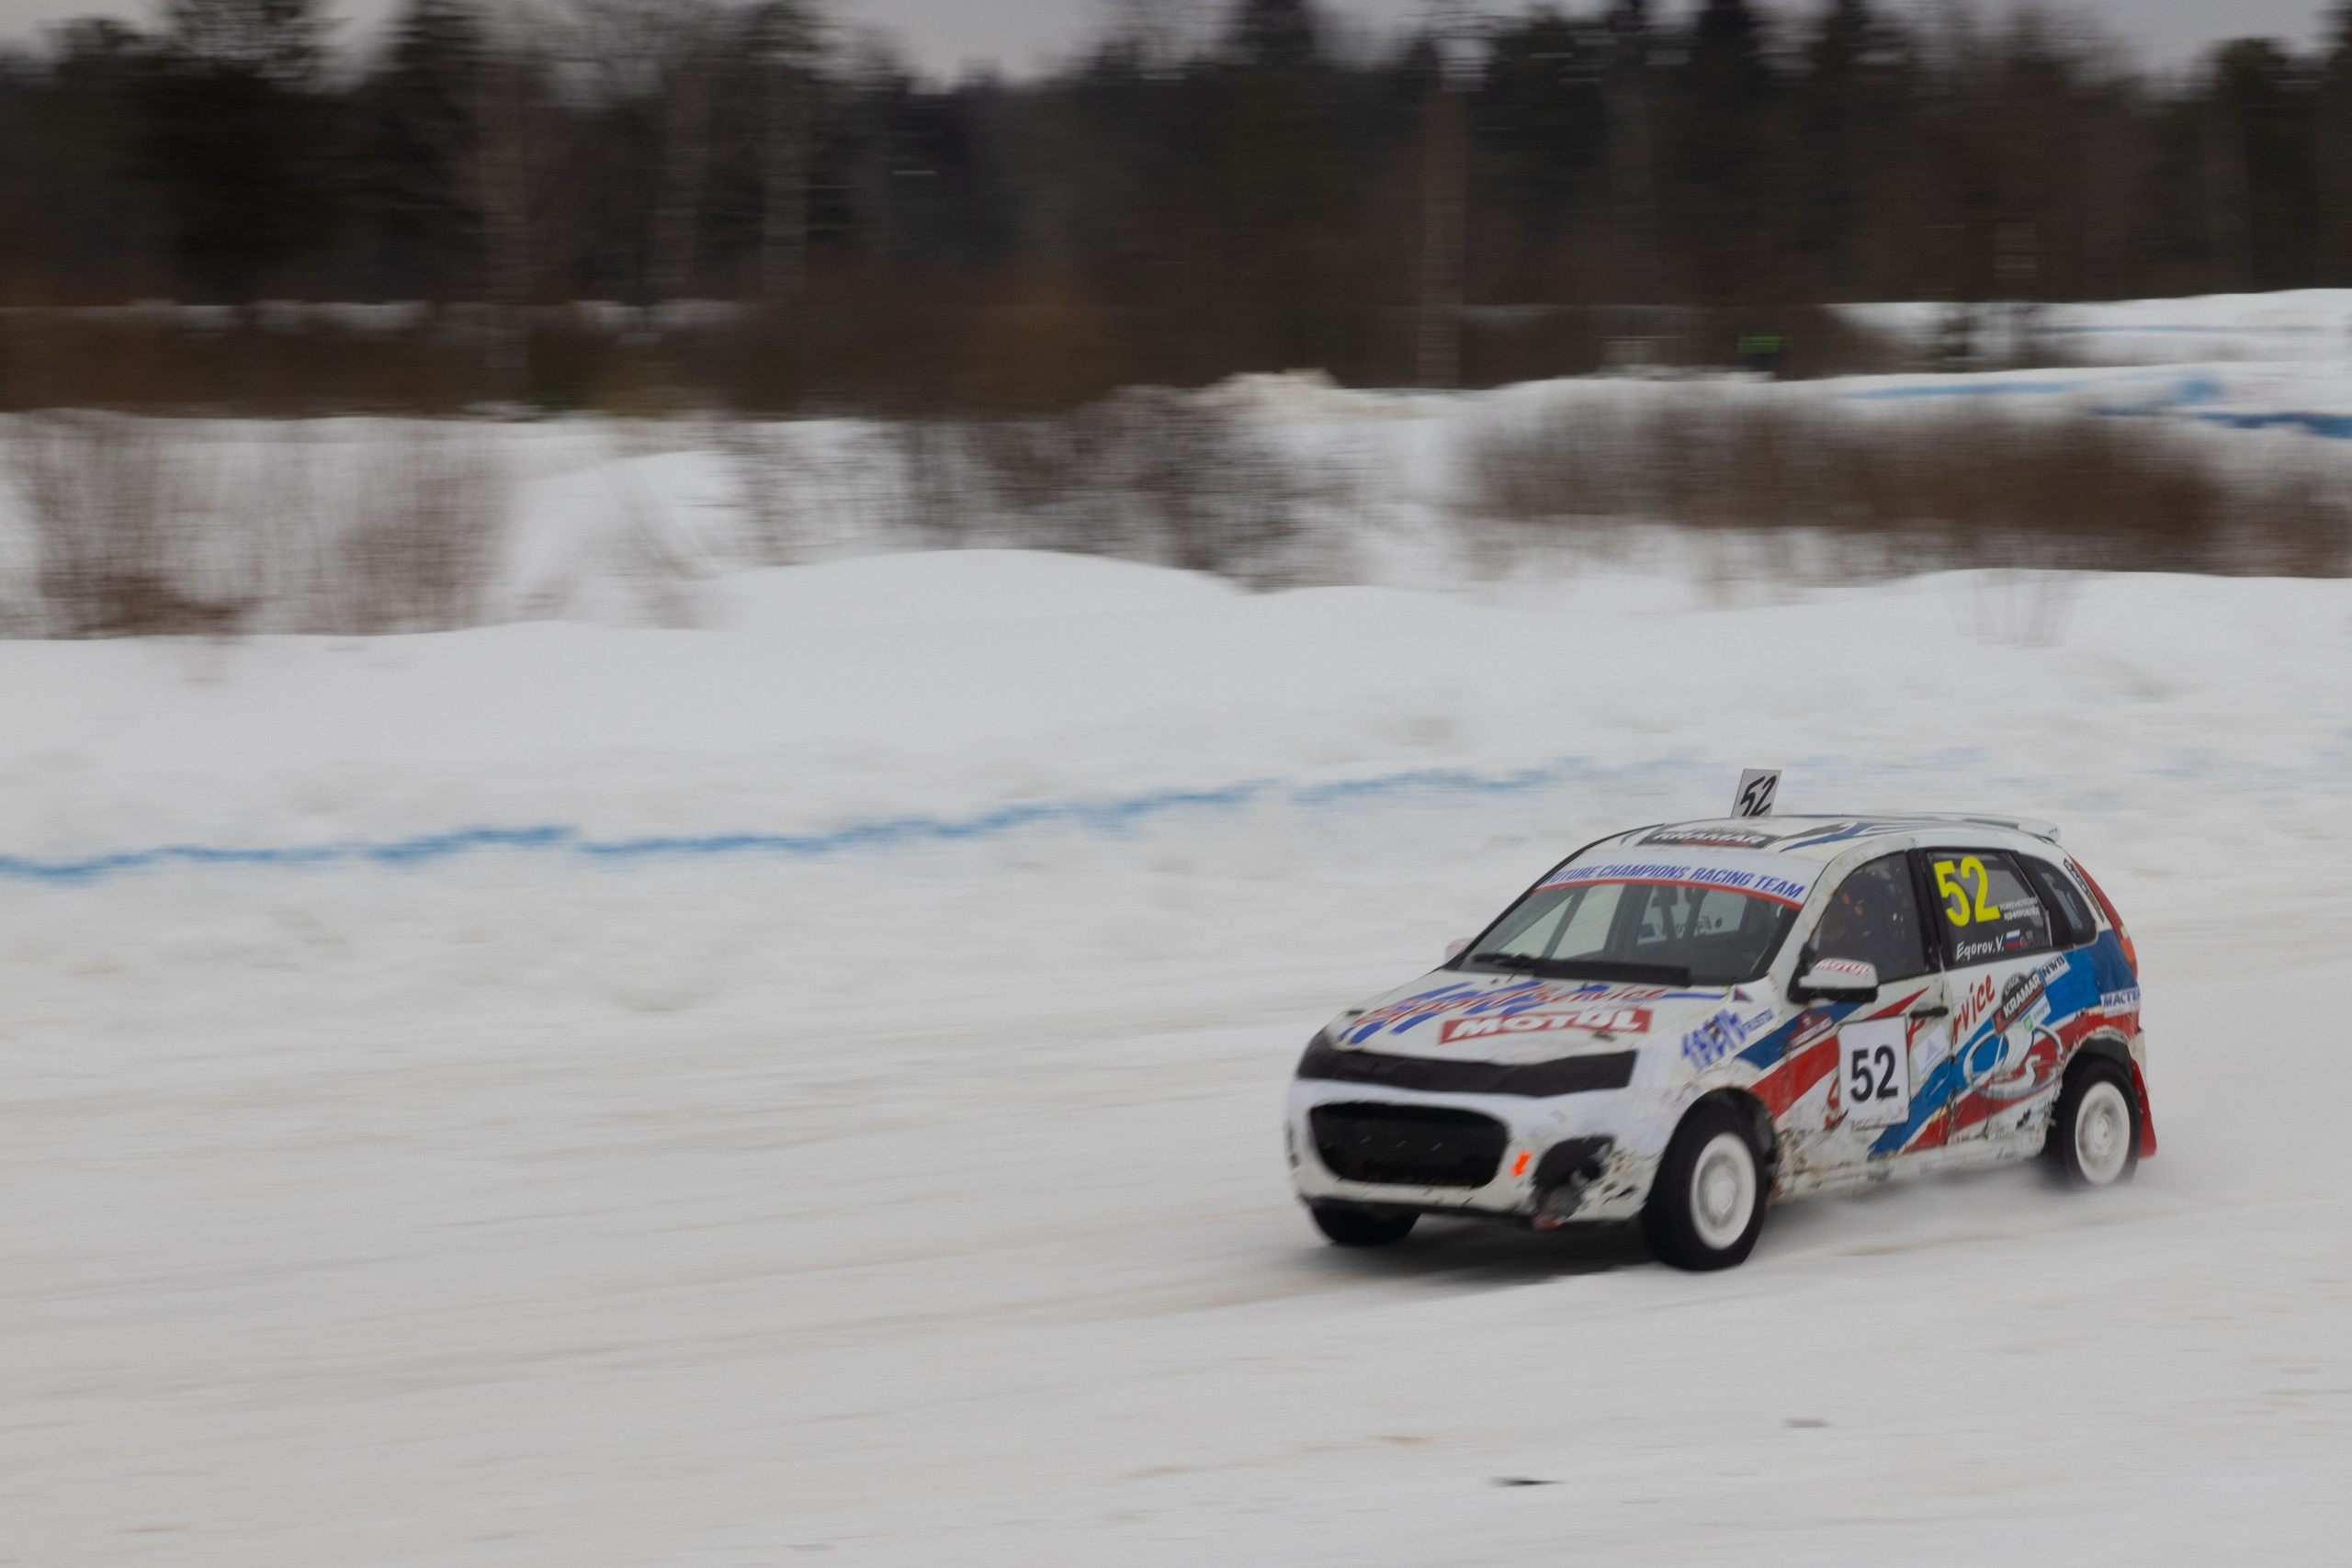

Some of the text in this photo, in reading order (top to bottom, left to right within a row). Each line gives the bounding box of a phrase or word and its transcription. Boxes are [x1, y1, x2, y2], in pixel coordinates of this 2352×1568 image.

[1739, 774, 1777, 817] 52
[1597, 863, 1691, 880] CHAMPIONS
[1689, 866, 1756, 887] RACING
[1753, 874, 1806, 899] TEAM
[1933, 855, 2001, 927] 52
[2041, 955, 2065, 977] NWB
[2003, 972, 2041, 1019] KRAMAR
[1446, 1009, 1643, 1040] MOTUL
[1850, 1044, 1899, 1101] 52
